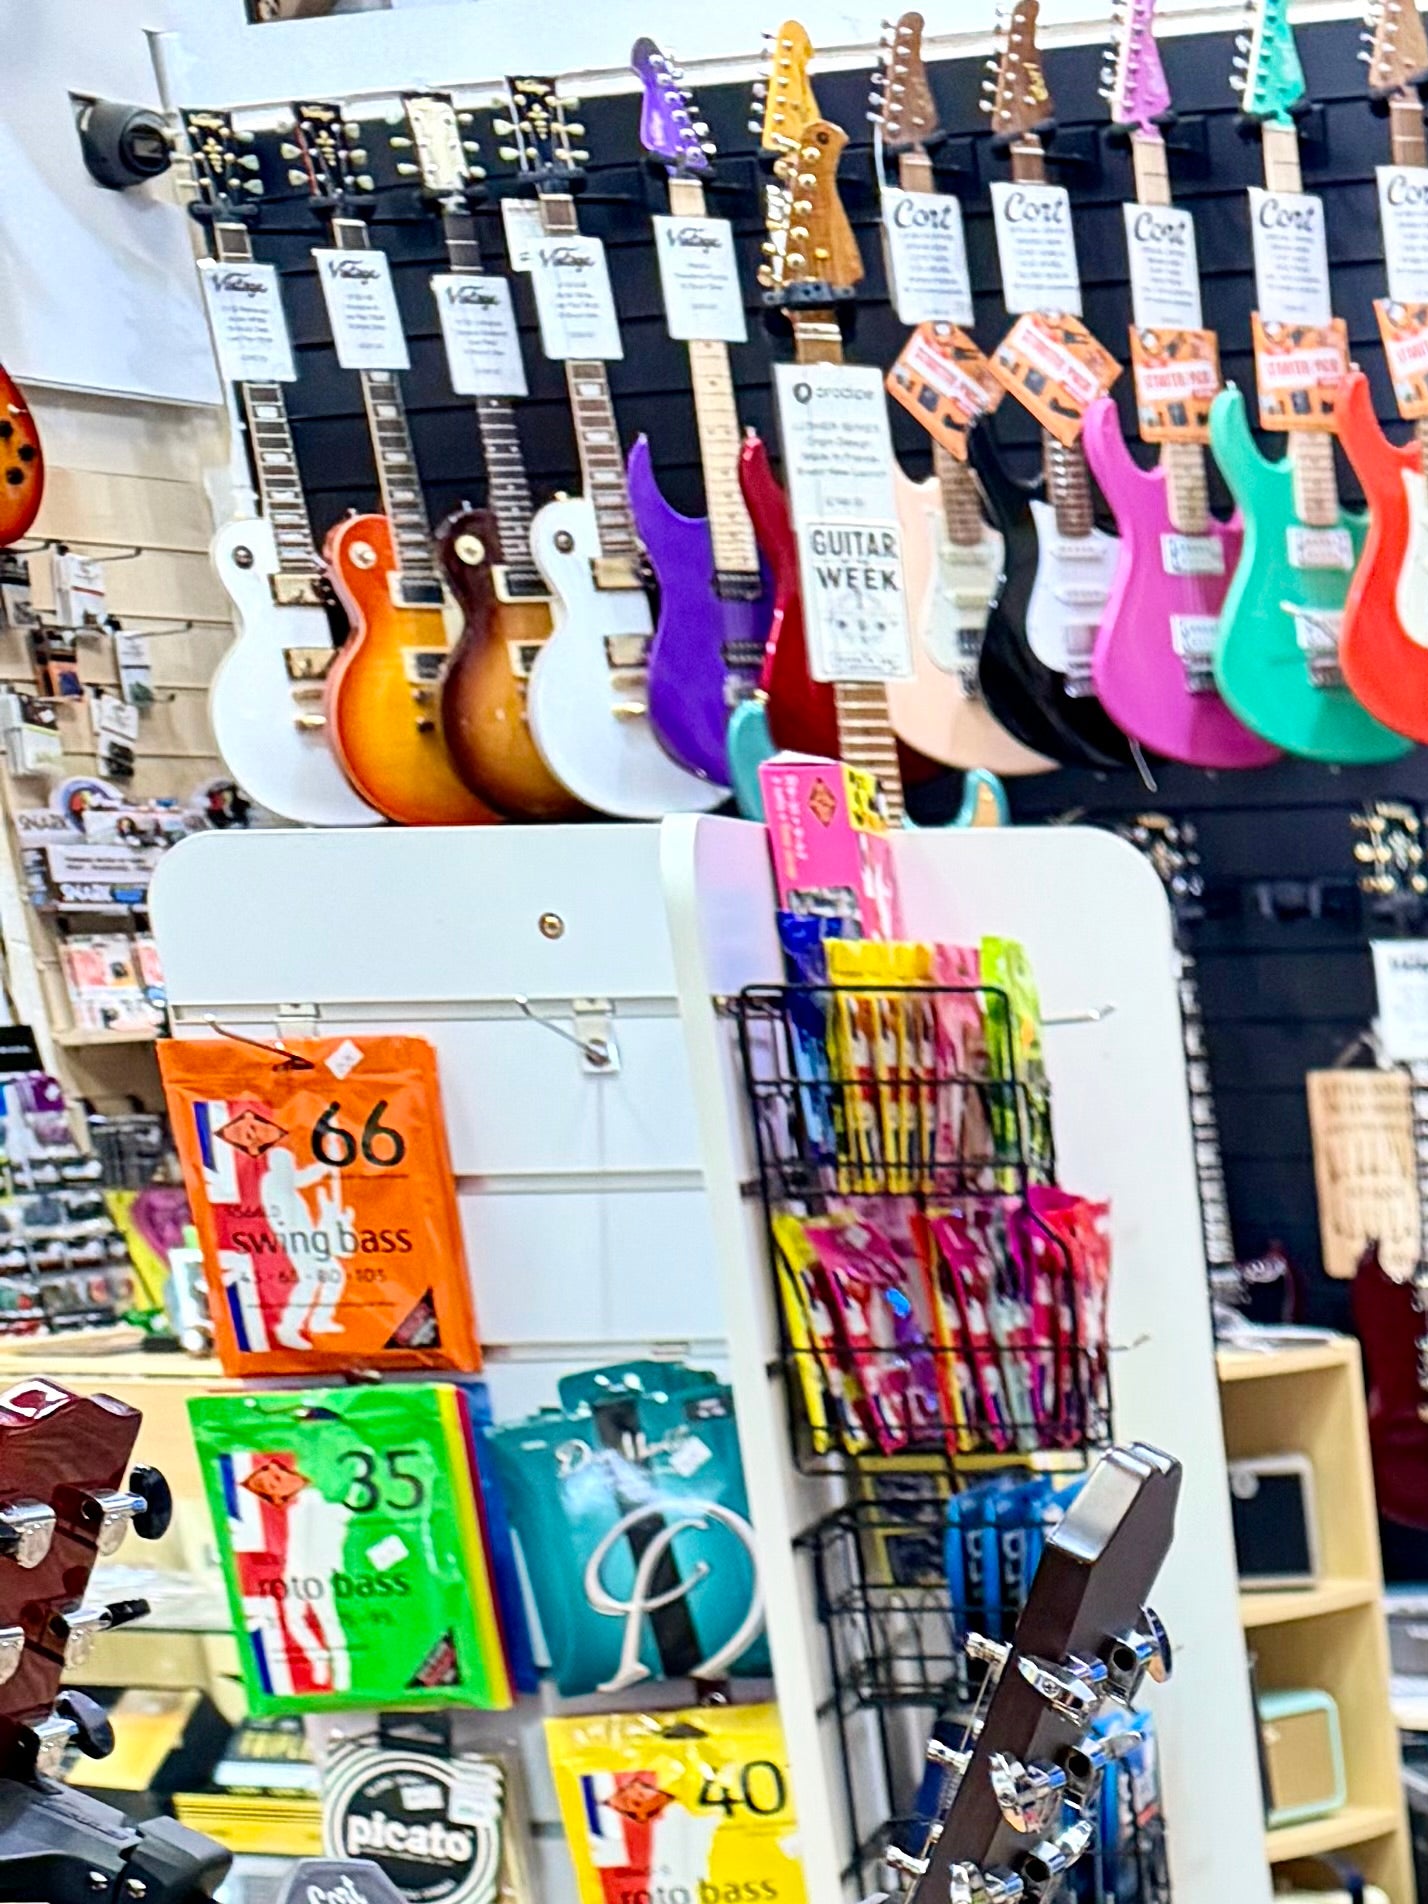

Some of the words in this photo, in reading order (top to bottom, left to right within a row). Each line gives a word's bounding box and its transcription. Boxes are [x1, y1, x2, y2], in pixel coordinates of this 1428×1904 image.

[894, 198, 952, 230] Cort
[1004, 191, 1064, 225] Cort
[1259, 198, 1315, 231] Cort
[1134, 211, 1187, 245] Cort
[811, 529, 898, 558] GUITAR
[816, 566, 900, 591] WEEK
[311, 1100, 405, 1167] 66
[232, 1222, 331, 1262] swing
[338, 1221, 413, 1254] bass
[336, 1449, 425, 1513] 35
[258, 1574, 325, 1601] roto
[331, 1567, 411, 1600] bass
[696, 1760, 787, 1818] 40
[347, 1808, 475, 1864] picato
